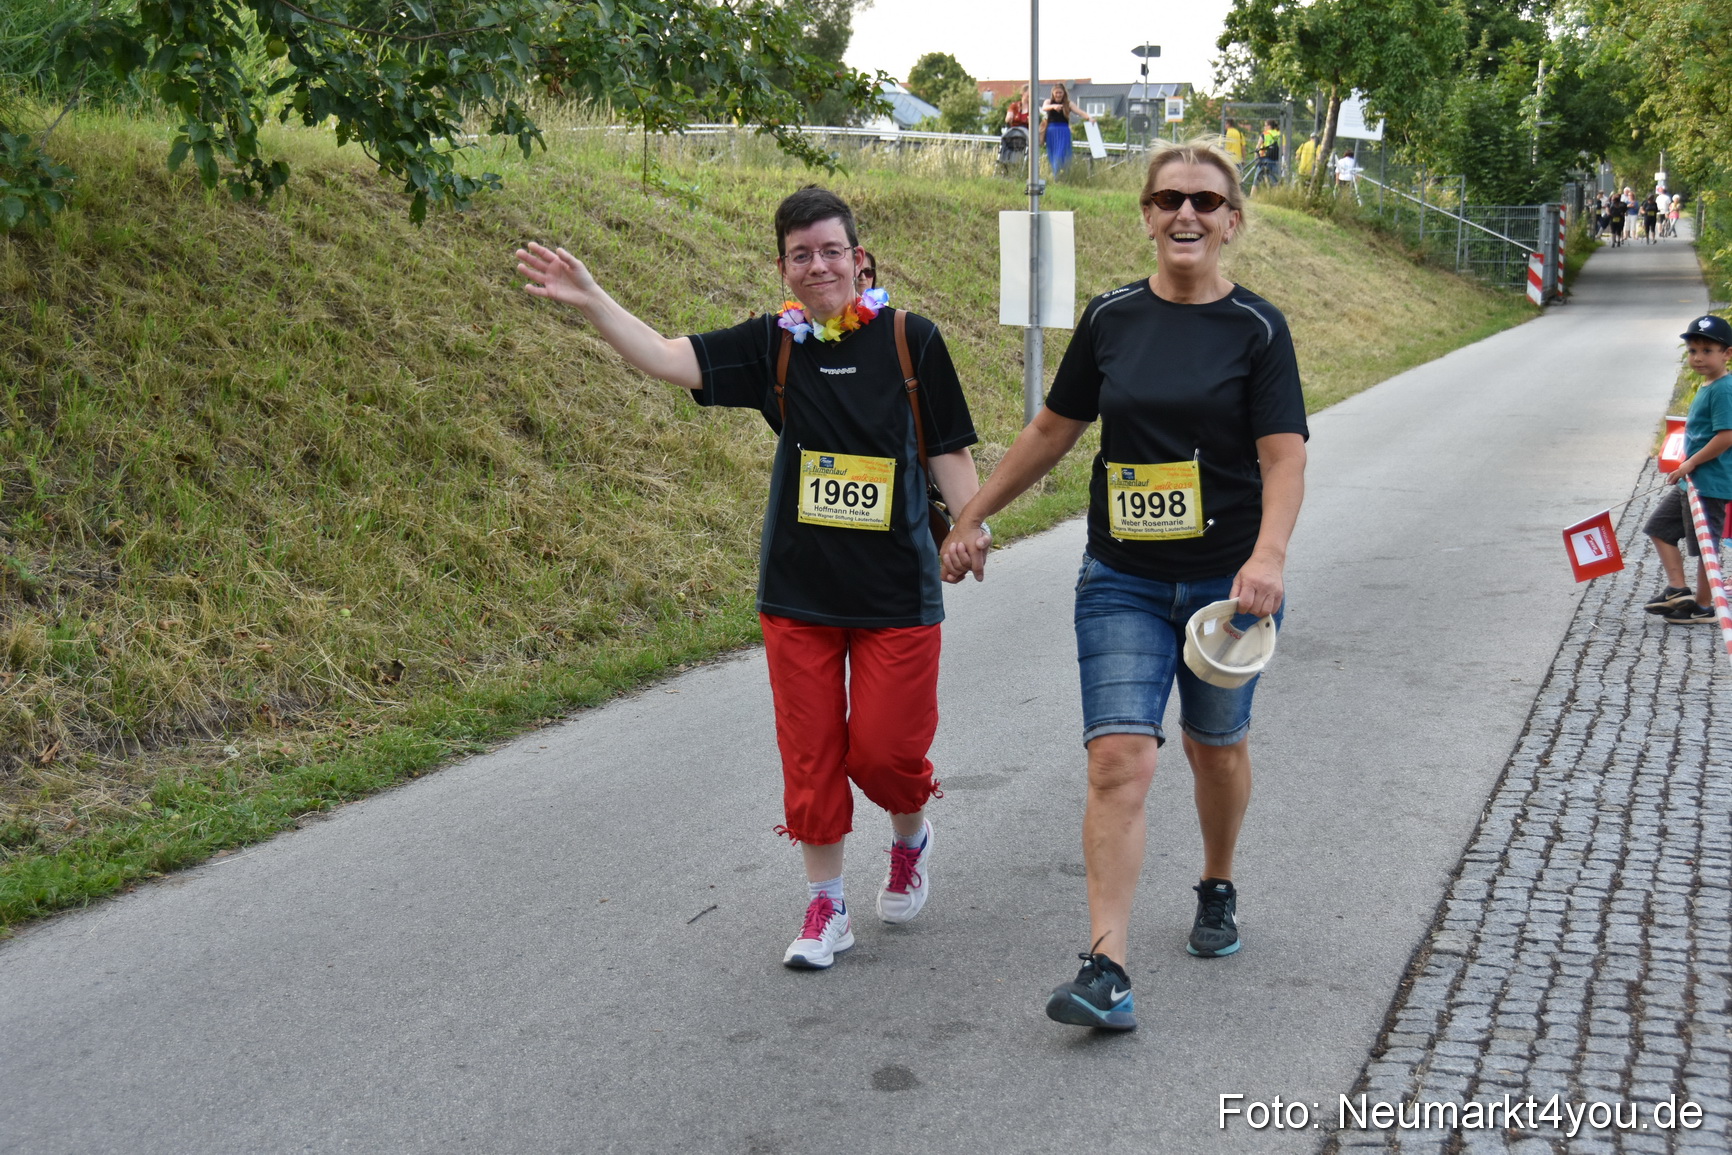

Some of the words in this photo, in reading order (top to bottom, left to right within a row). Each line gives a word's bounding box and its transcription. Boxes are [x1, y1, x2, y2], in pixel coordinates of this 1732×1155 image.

[810, 478, 879, 509] 1969
[814, 505, 847, 515] Hoffmann
[849, 509, 870, 517] Heike
[1117, 490, 1187, 519] 1998
[1121, 519, 1141, 527] Weber
[1142, 519, 1184, 527] Rosemarie
